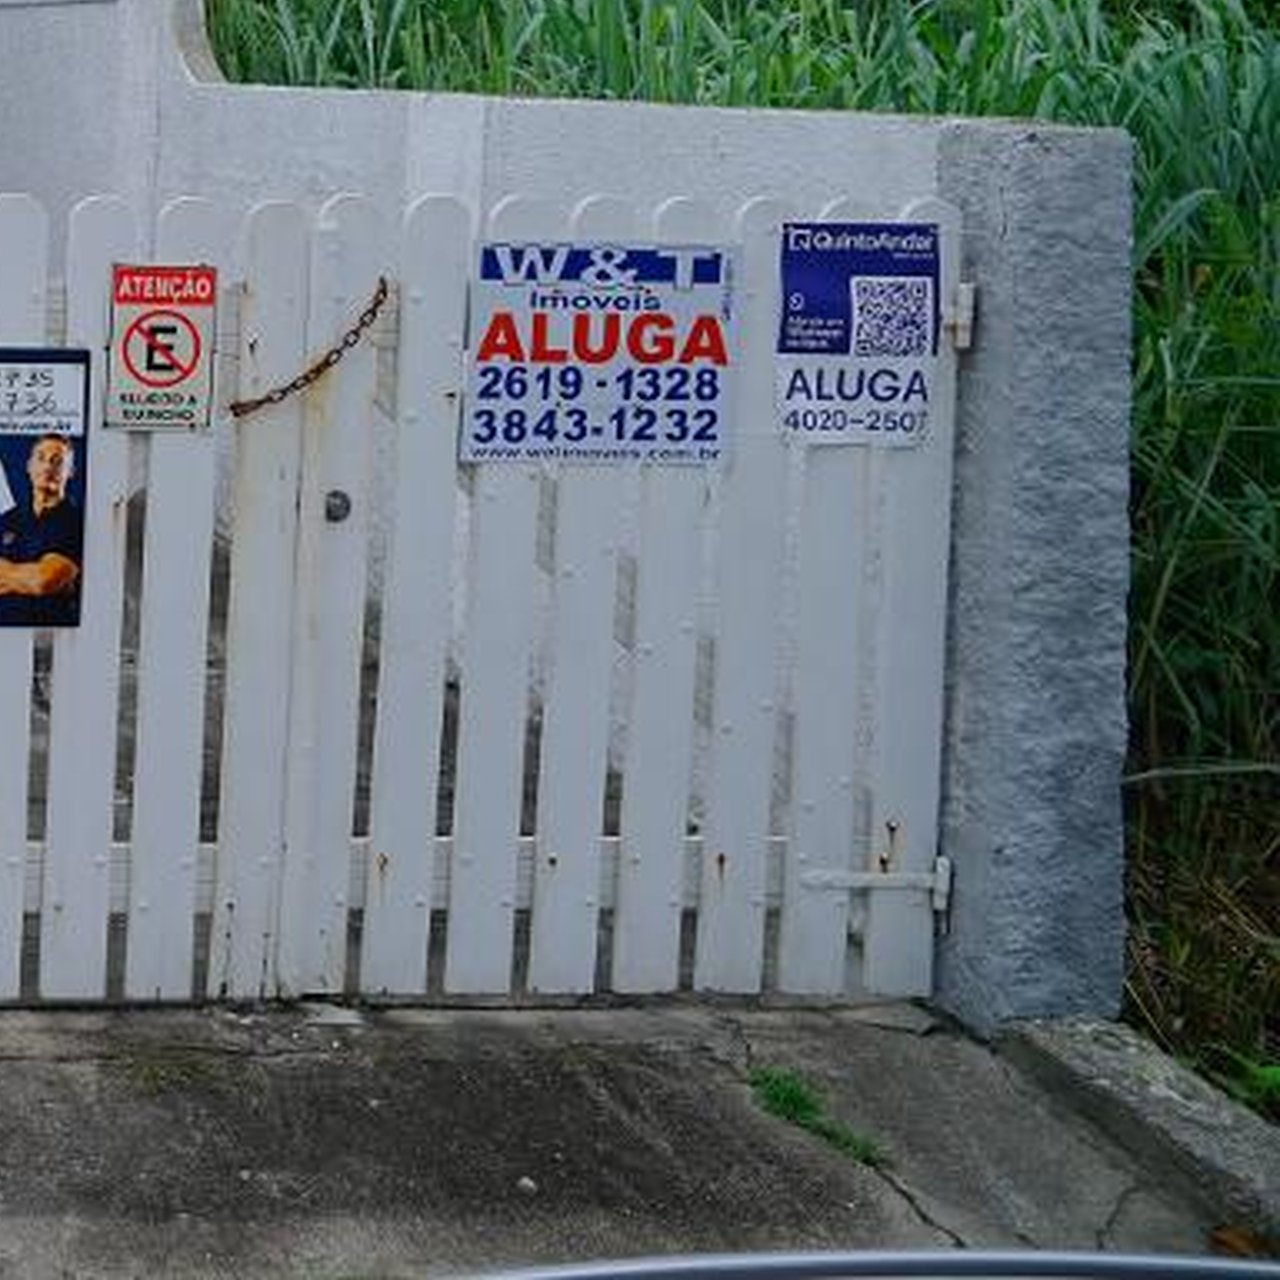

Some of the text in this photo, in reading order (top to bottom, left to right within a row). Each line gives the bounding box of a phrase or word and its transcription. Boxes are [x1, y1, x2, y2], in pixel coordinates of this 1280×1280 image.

[118, 270, 212, 302] ATENÇÃO
[476, 312, 728, 366] ALUGA
[785, 368, 929, 403] ALUGA
